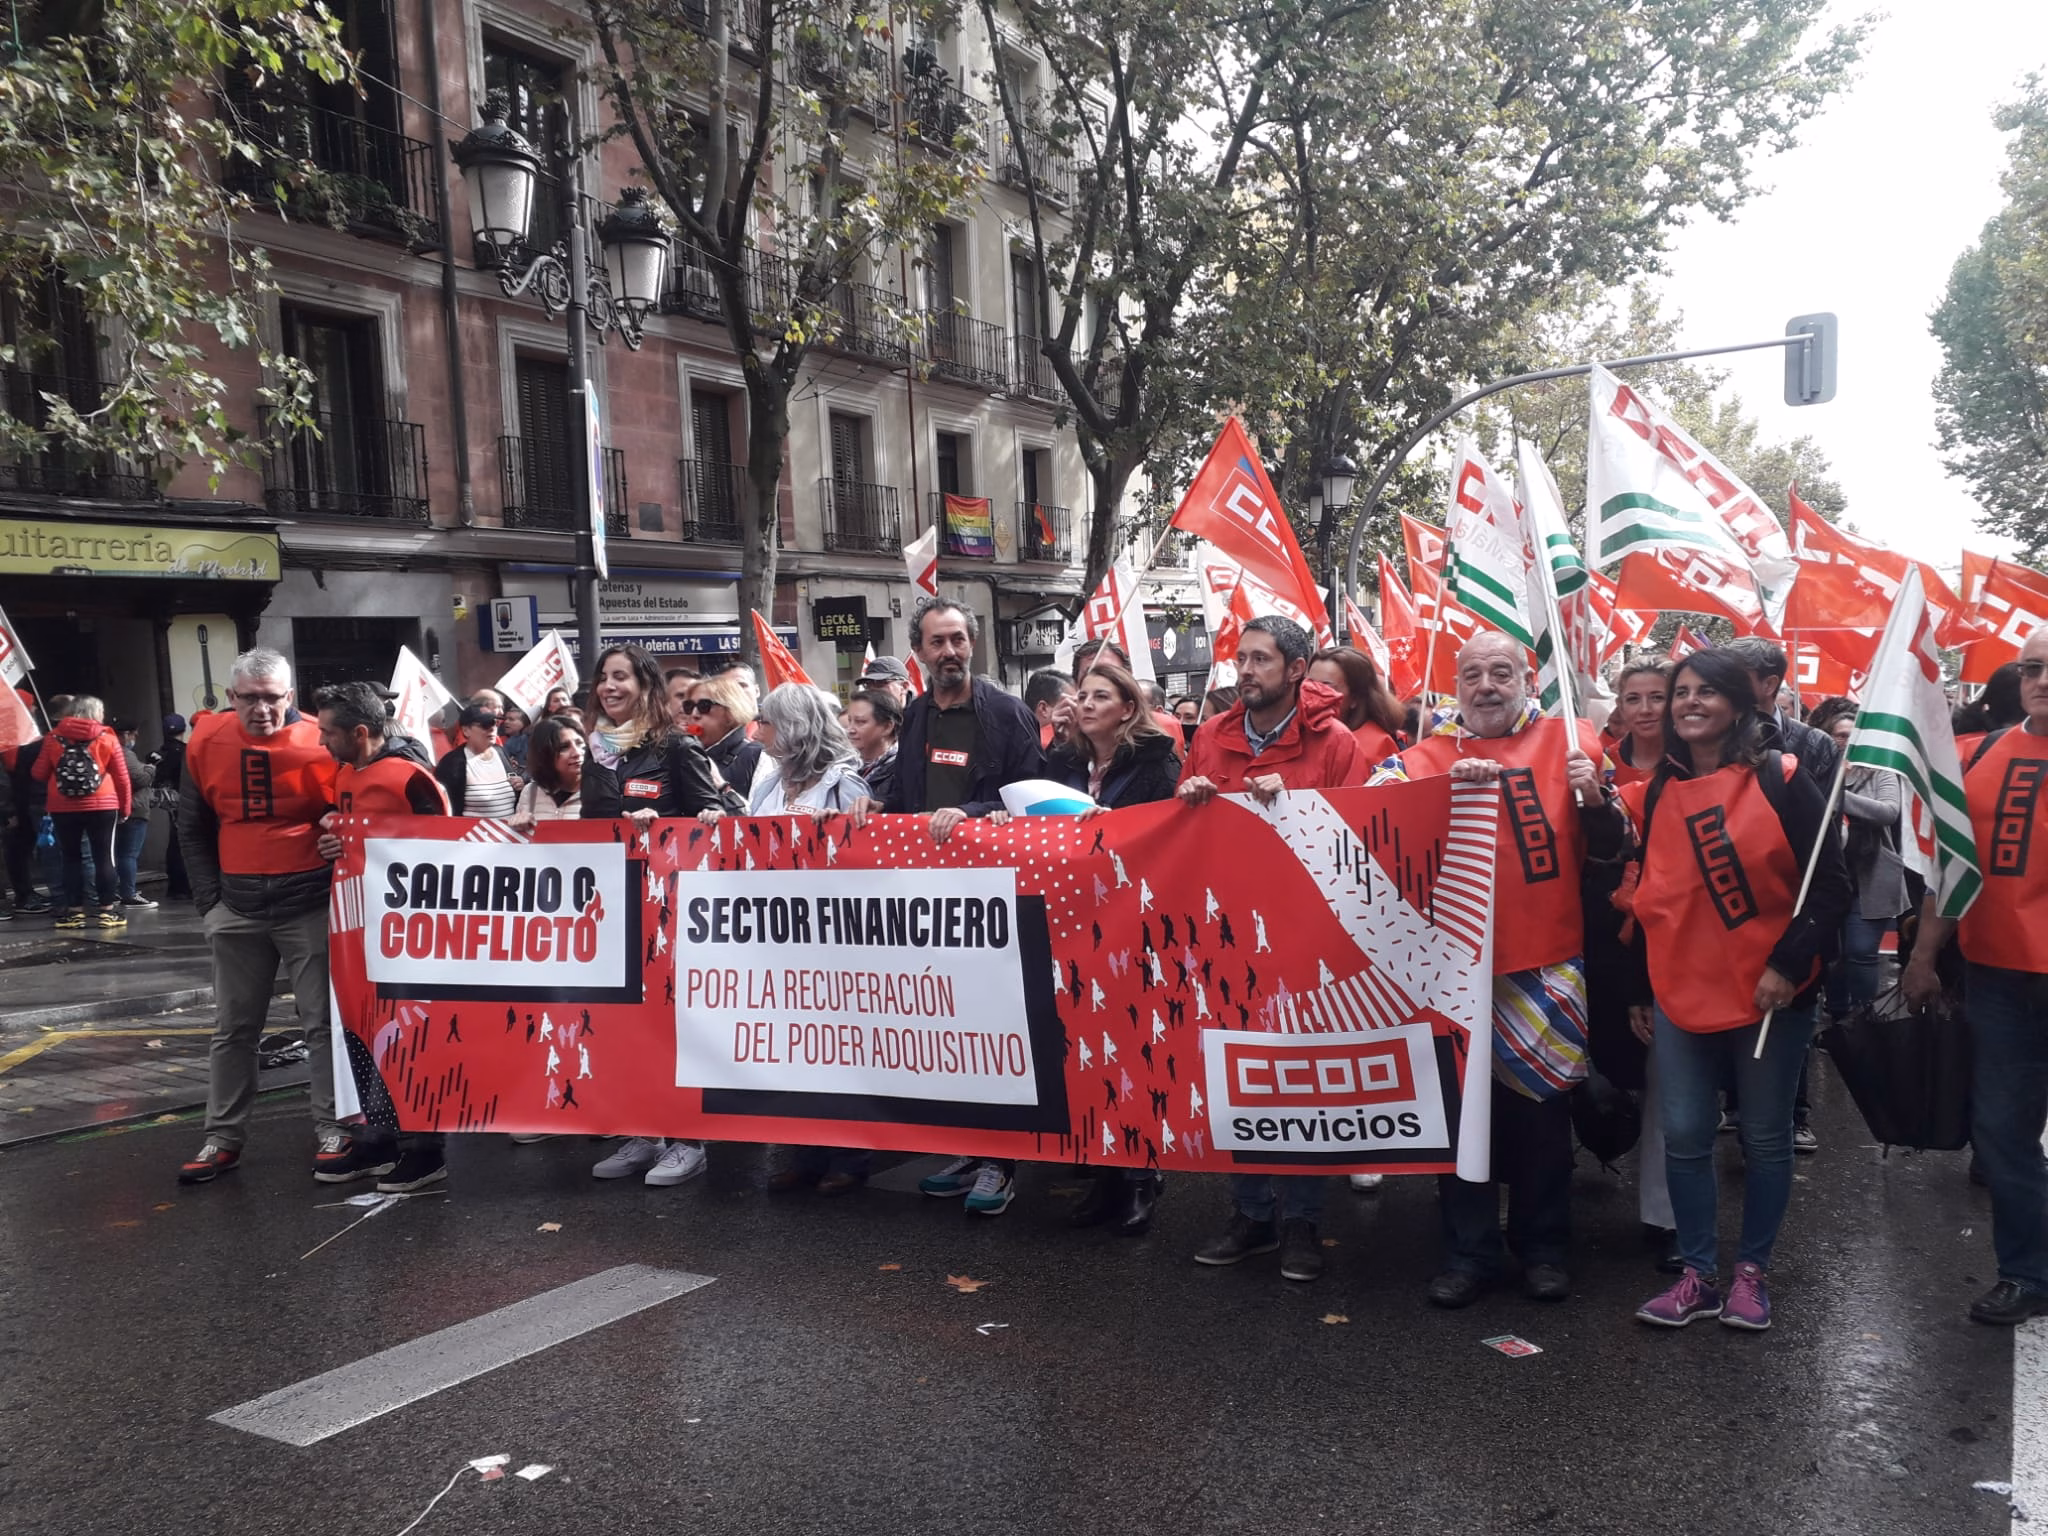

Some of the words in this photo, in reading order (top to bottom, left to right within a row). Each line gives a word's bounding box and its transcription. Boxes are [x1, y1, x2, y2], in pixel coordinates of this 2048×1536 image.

[198, 559, 267, 577] Madrid
[599, 597, 641, 610] Apuestas
[643, 596, 657, 608] del
[659, 597, 688, 608] Estado
[636, 584, 642, 596] y
[821, 626, 834, 637] BE
[836, 625, 861, 636] FREE
[847, 613, 856, 624] &
[639, 637, 676, 652] Lotería
[690, 639, 703, 651] 71
[934, 751, 966, 764] CCOO
[1506, 774, 1555, 876] CCOO
[1993, 765, 2040, 868] CCOO
[384, 861, 562, 914] SALARIO
[1693, 813, 1751, 920] CCOO
[379, 911, 598, 964] CONFLICTO
[687, 896, 812, 945] SECTOR
[815, 896, 1010, 950] FINANCIERO
[687, 968, 739, 1010] POR
[746, 968, 777, 1010] LA
[783, 965, 956, 1018] RECUPERACIÓN
[733, 1022, 781, 1064] DEL
[788, 1022, 866, 1067] PODER
[870, 1026, 1027, 1077] ADQUISITIVO
[1236, 1053, 1400, 1095] CCOO
[1231, 1108, 1423, 1143] servicios
